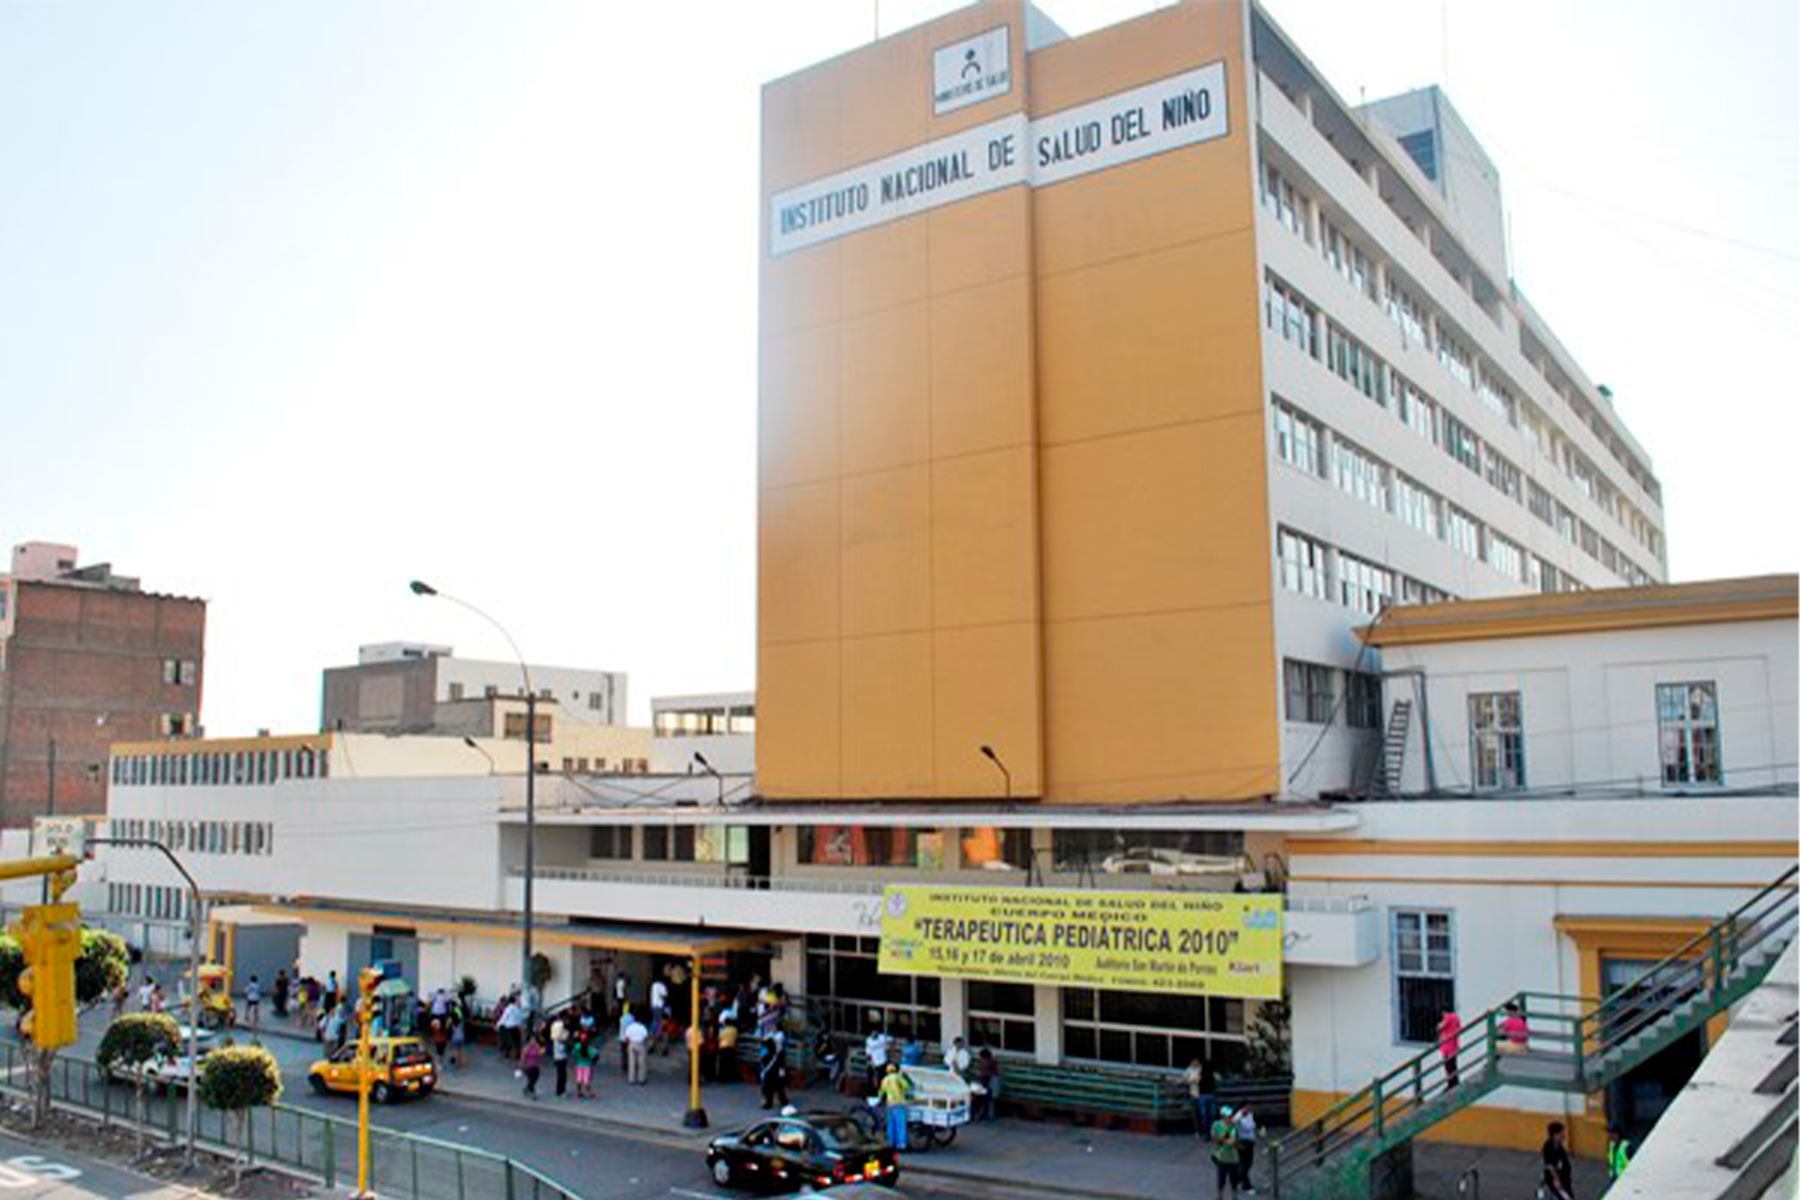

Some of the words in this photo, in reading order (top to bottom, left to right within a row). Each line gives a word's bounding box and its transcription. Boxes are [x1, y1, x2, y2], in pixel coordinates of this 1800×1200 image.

[780, 182, 869, 235] INSTITUTO
[880, 150, 974, 206] NACIONAL
[987, 133, 1014, 171] DE
[1038, 121, 1101, 167] SALUD
[1111, 107, 1150, 146] DEL
[929, 893, 999, 904] INSTITUTO
[1001, 895, 1070, 907] NACIONAL
[1076, 898, 1093, 907] DE
[1099, 899, 1146, 910] SALUD
[1150, 900, 1177, 911] DEL
[990, 907, 1066, 919] CUERPO
[961, 951, 969, 965] y
[972, 950, 987, 963] 17
[989, 951, 1004, 964] de
[1007, 951, 1034, 965] abril
[1038, 953, 1071, 968] 2010
